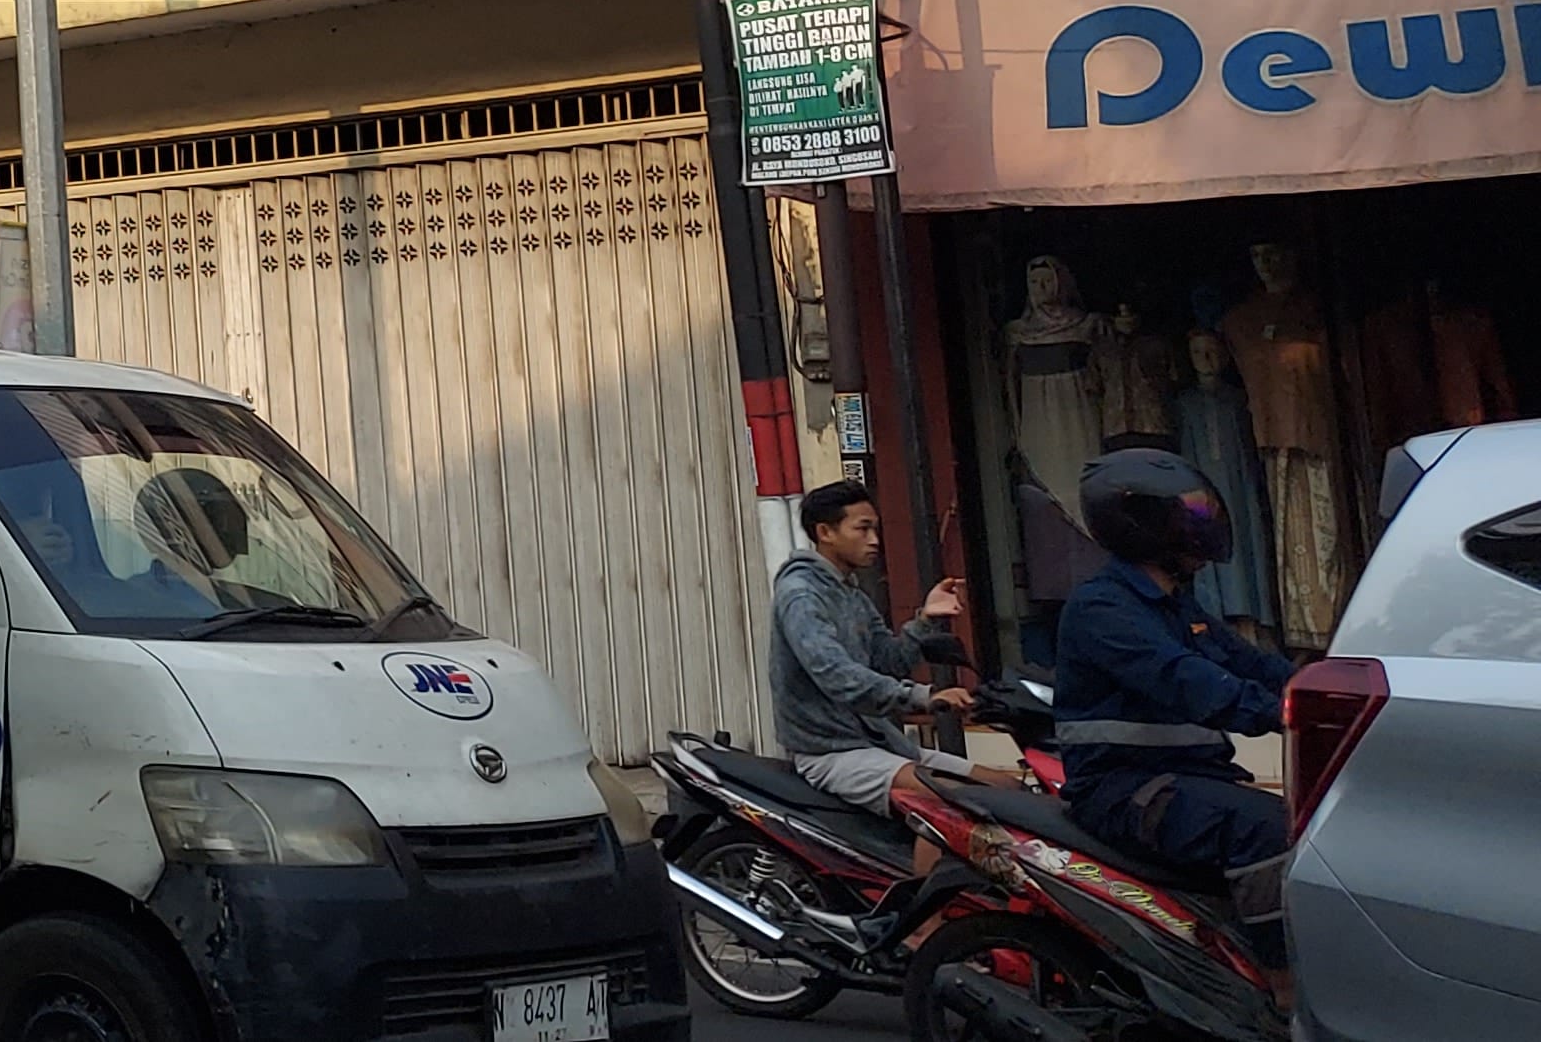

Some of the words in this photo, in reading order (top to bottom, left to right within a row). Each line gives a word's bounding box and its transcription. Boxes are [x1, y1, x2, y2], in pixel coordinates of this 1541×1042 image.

[739, 14, 798, 38] PUSAT
[802, 6, 870, 28] TERAPI
[741, 31, 804, 55] TINGGI
[808, 23, 871, 48] BADAN
[743, 48, 812, 73] TAMBAH
[815, 45, 842, 65] 1-8
[845, 42, 873, 60] CM
[747, 75, 793, 91] LANGSUNG
[749, 105, 759, 117] DI
[762, 102, 795, 116] TEMPAT
[762, 133, 802, 153] 0853
[804, 130, 842, 150] 2888
[843, 125, 880, 145] 3100
[405, 663, 475, 695] JNE
[494, 992, 504, 1031] N
[524, 983, 566, 1026] 8437
